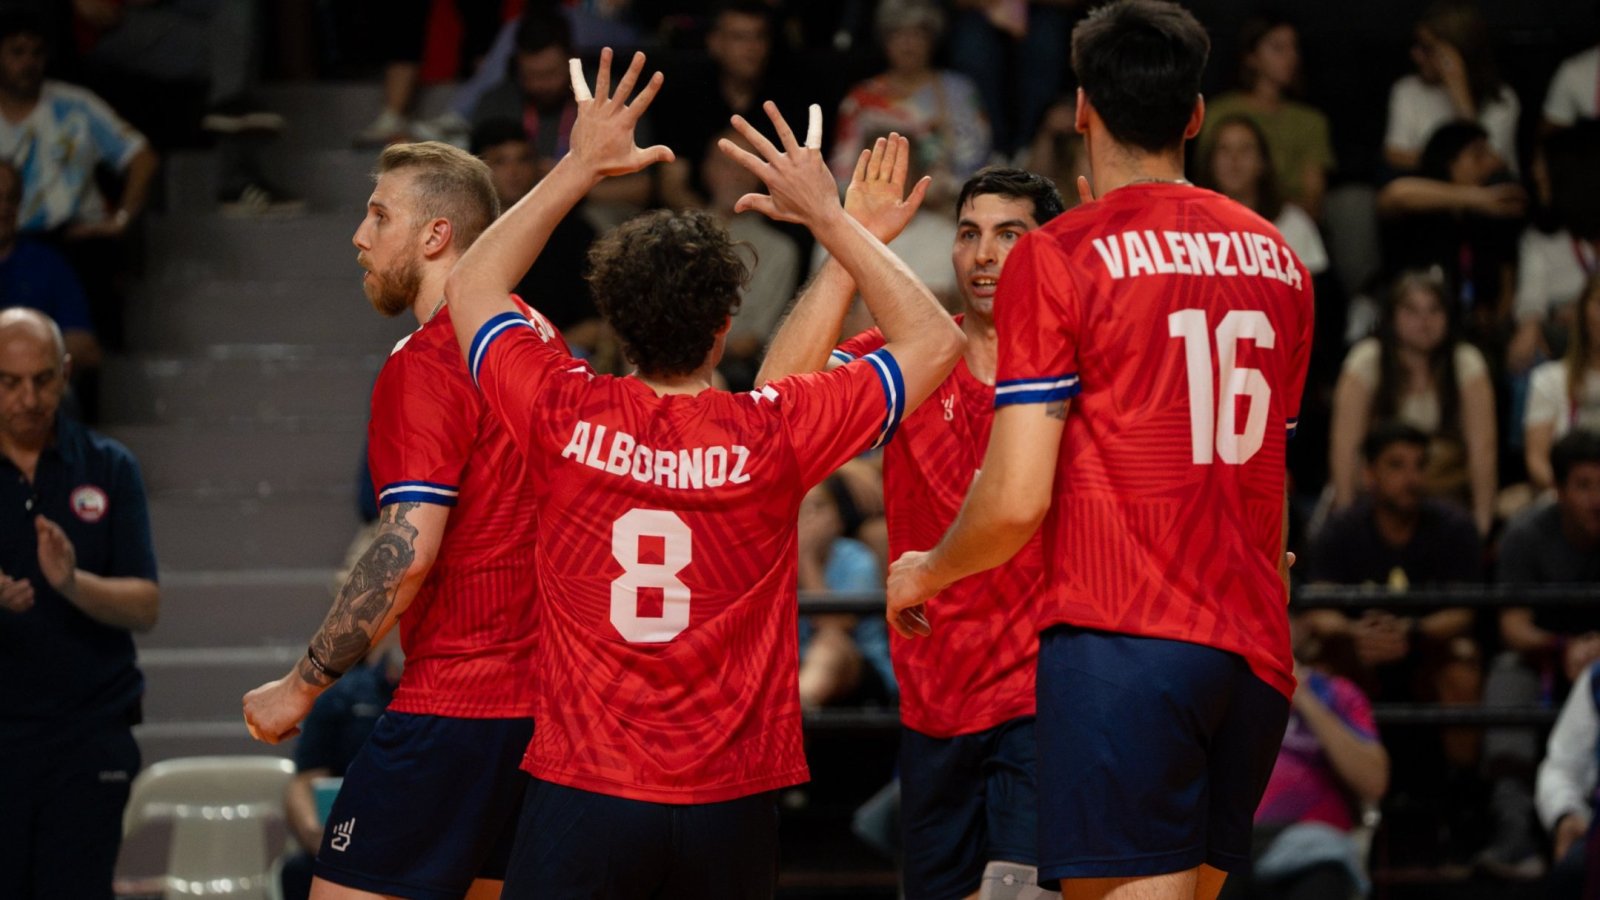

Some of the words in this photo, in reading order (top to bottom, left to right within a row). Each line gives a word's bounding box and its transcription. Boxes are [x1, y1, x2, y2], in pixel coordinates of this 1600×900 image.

[1092, 230, 1302, 291] VALENZUELA
[1168, 308, 1276, 464] 16
[561, 420, 751, 489] ALBORNOZ
[610, 508, 692, 643] 8
